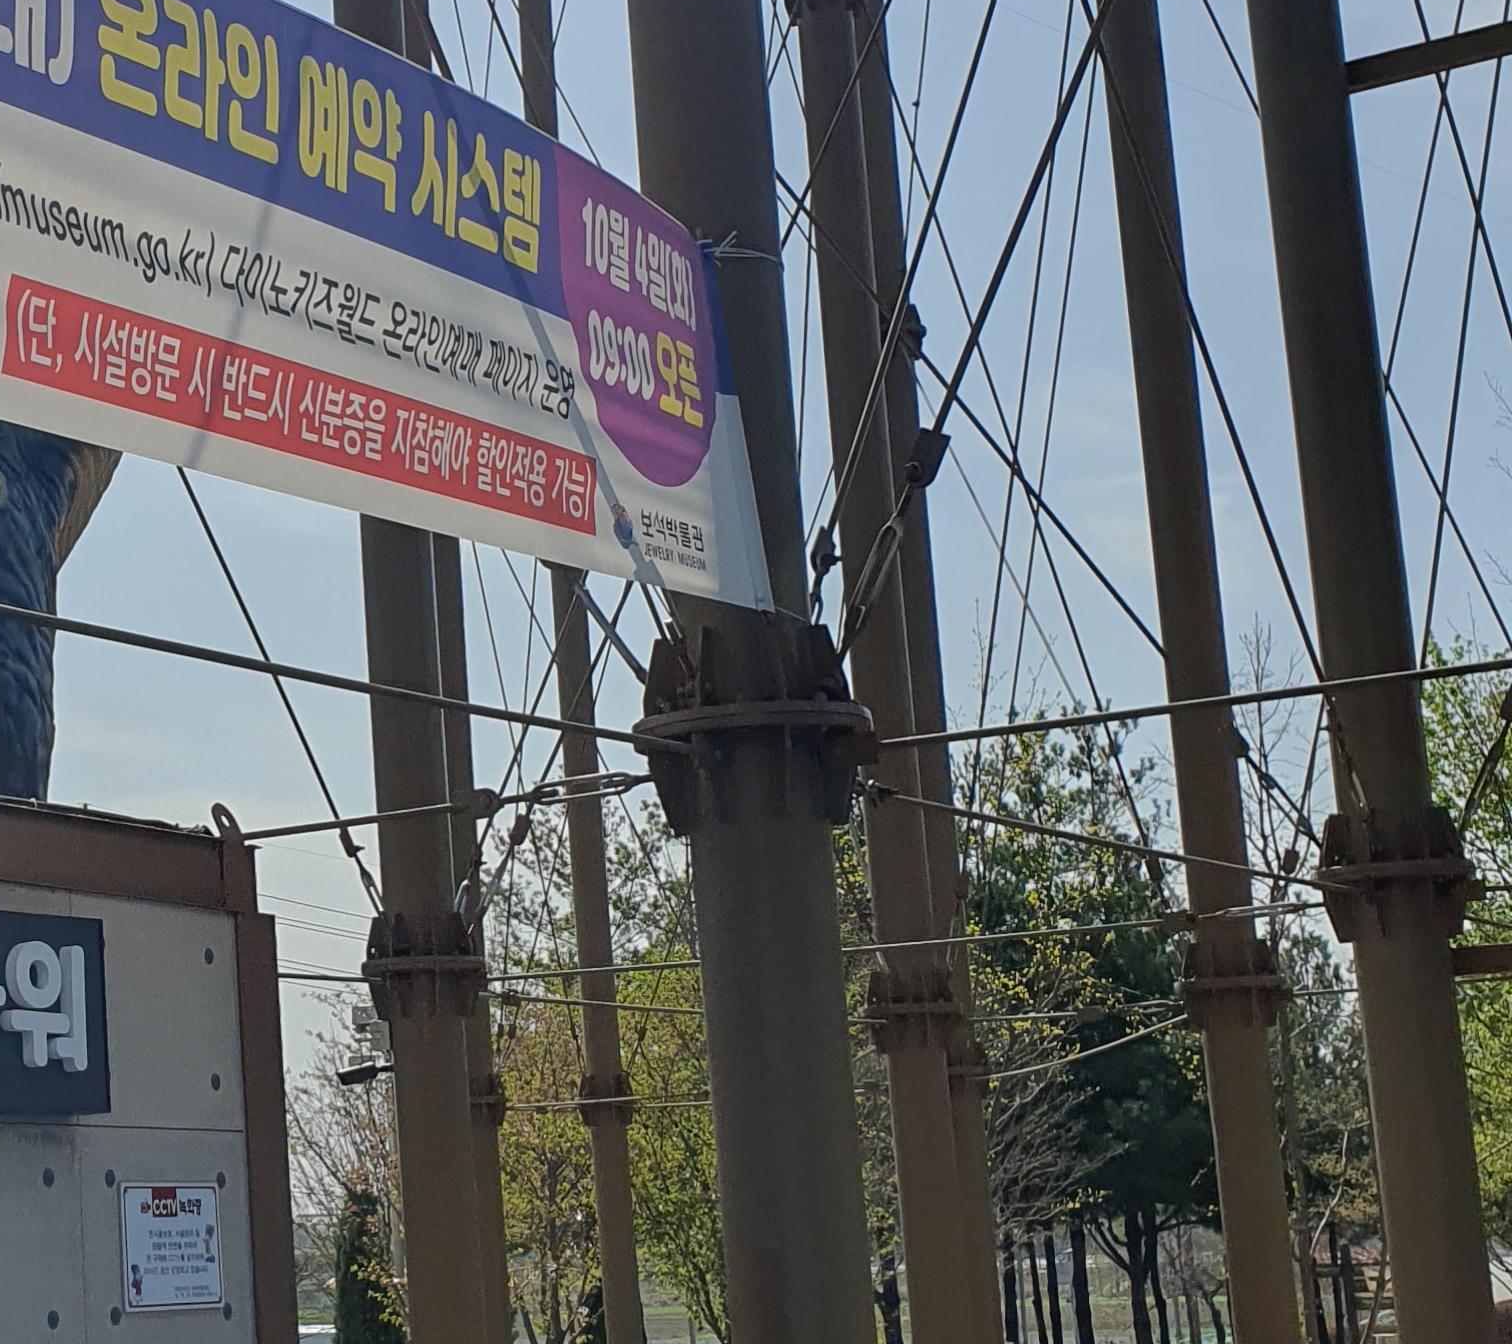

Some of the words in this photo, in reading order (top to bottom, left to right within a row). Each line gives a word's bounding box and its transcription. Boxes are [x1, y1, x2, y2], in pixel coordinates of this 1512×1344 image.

[299, 55, 402, 213] 예약
[411, 110, 541, 273] 시스템
[582, 197, 630, 293] 10월
[635, 225, 696, 332] 4일(화)
[221, 245, 381, 345] 다이노키즈월드
[382, 302, 482, 387] 온라인예매
[484, 339, 540, 408] 페이지
[541, 359, 575, 420] 운영
[588, 309, 655, 400] 09:00
[656, 331, 703, 428] 오픈
[17, 289, 63, 373] (단,
[74, 312, 181, 402] 시설방문
[188, 347, 215, 413] 시
[222, 355, 295, 435] 반드시
[299, 380, 386, 461] 신분증을
[391, 409, 472, 485] 지참해야
[476, 432, 547, 506] 할인적용
[551, 458, 590, 521] 가능)
[641, 508, 705, 553] 보석박물관
[152, 1198, 177, 1215] CCTV
